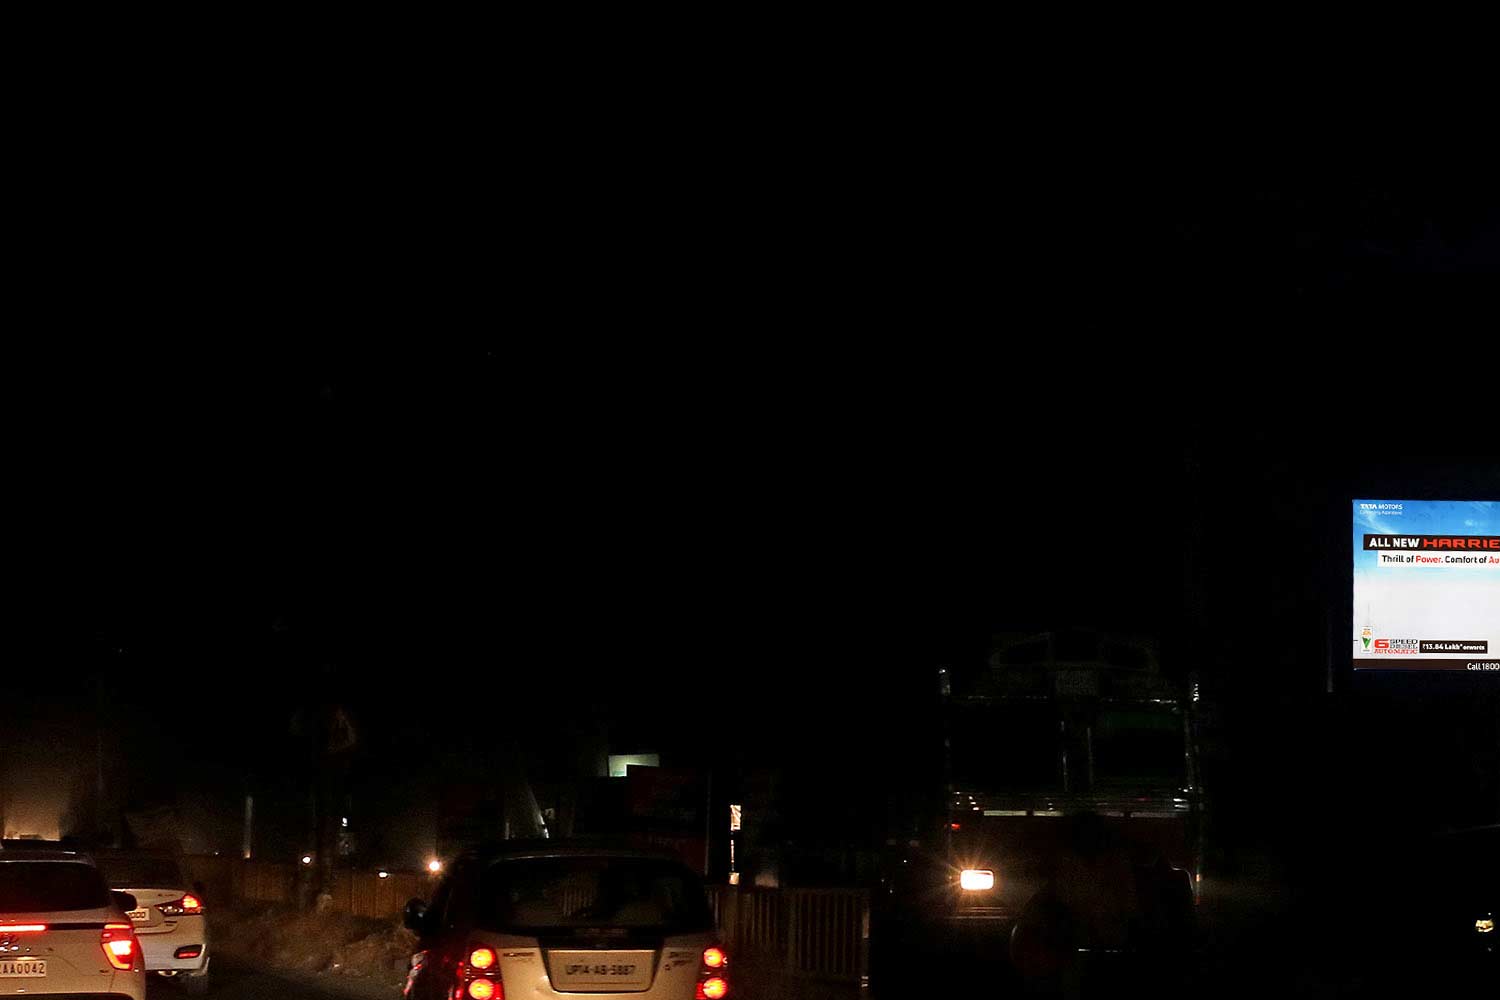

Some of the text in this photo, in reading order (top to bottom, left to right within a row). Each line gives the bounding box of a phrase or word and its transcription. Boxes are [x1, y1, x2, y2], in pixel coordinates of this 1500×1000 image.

[1369, 537, 1390, 548] ALL
[1392, 537, 1420, 548] NEW
[1382, 554, 1404, 563] Thrill
[1406, 555, 1415, 563] of
[1416, 555, 1443, 564] Power.
[1445, 555, 1477, 564] Comfort
[1479, 555, 1488, 564] of
[1374, 638, 1389, 649] 6
[1467, 662, 1481, 671] Call
[1482, 663, 1500, 671] 1800
[0, 963, 45, 974] AA0042
